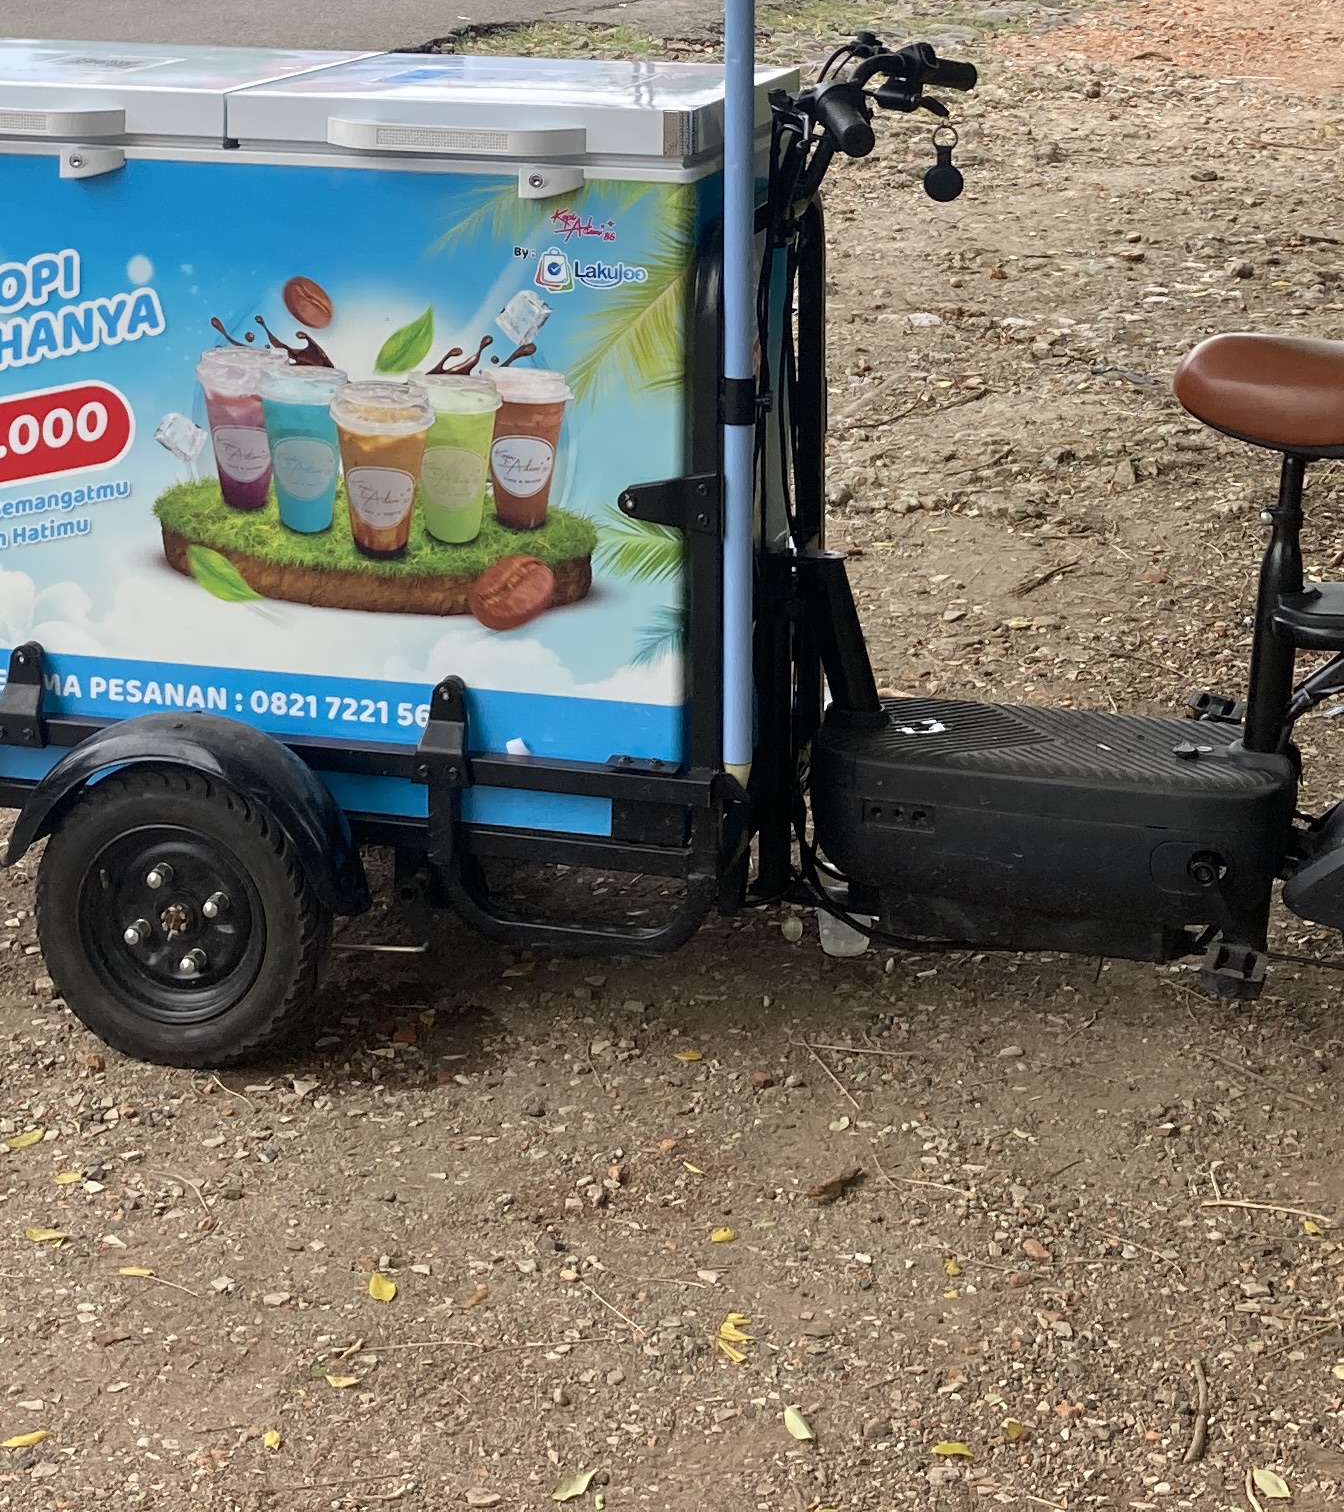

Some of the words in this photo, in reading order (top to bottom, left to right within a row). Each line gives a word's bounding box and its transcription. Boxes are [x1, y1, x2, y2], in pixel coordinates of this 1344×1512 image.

[514, 247, 529, 258] By
[13, 517, 91, 545] Hatimu
[90, 676, 227, 710] PESANAN
[250, 690, 317, 718] 0821
[325, 696, 389, 724] 7221
[397, 702, 431, 728] 56
